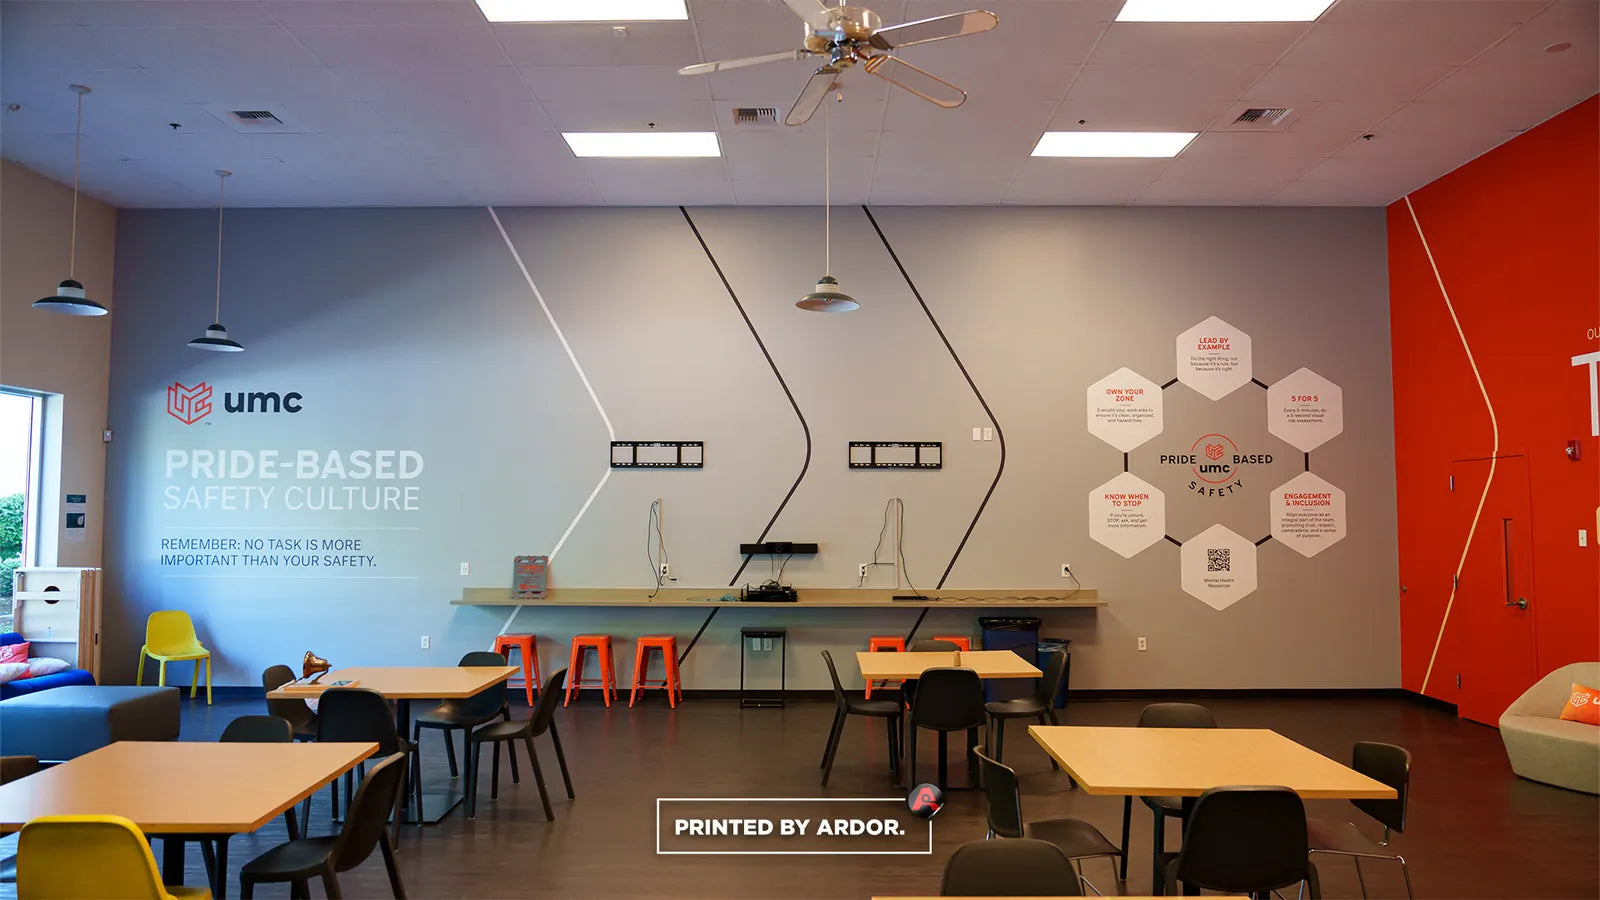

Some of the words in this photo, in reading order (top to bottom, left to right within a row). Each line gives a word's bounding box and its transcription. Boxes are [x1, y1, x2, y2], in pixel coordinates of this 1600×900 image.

[224, 391, 303, 414] umc
[165, 449, 424, 480] PRIDE-BASED
[1160, 455, 1197, 464] PRIDE
[1233, 455, 1273, 464] BASED
[1199, 464, 1230, 473] umc
[1188, 479, 1243, 497] SAFETY
[163, 486, 275, 511] SAFETY
[284, 486, 420, 511] CULTURE
[161, 539, 241, 551] REMEMBER:
[244, 539, 264, 551] NO
[269, 539, 301, 551] TASK
[306, 539, 318, 551] IS
[322, 539, 362, 551] MORE
[160, 554, 238, 566] IMPORTANT
[243, 555, 279, 567] THAN
[284, 555, 319, 567] YOUR
[323, 555, 377, 567] SAFETY.
